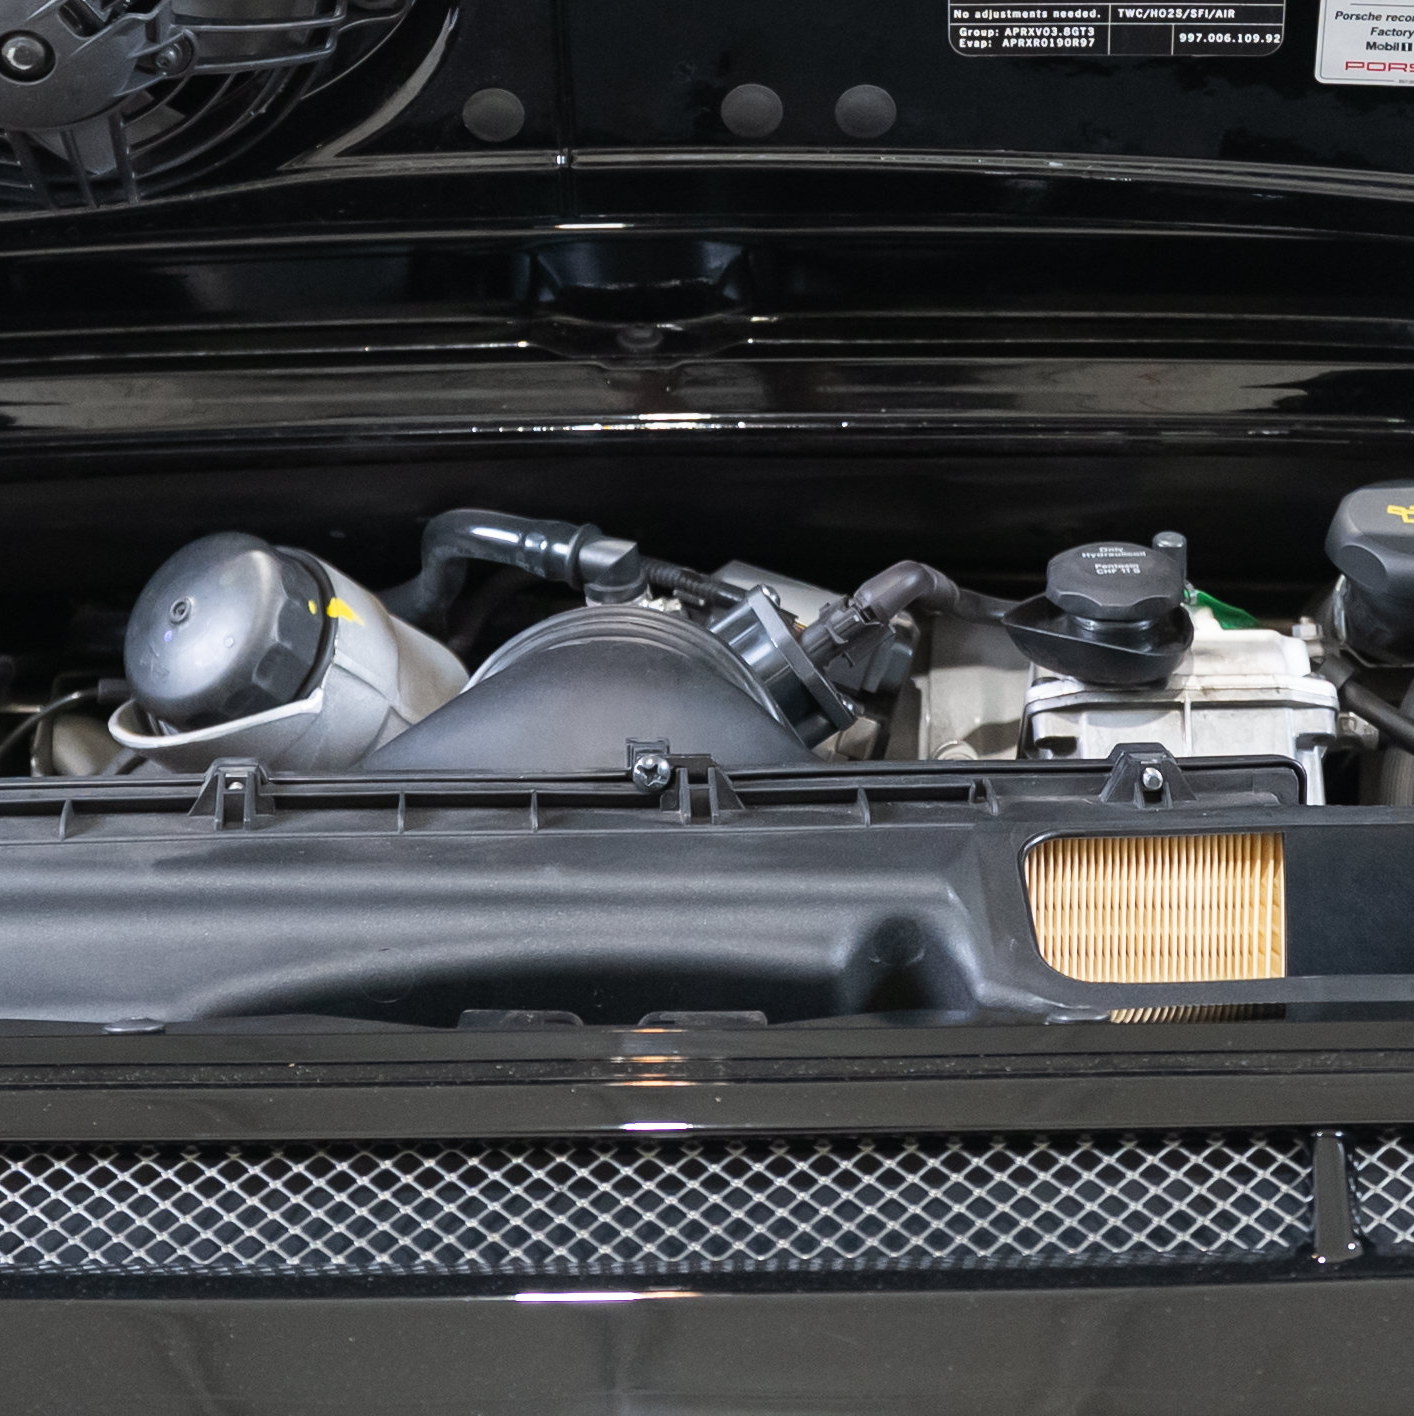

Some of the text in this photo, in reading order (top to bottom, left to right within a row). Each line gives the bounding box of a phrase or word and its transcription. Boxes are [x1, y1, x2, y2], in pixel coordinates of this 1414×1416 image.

[954, 9, 1101, 20] No adjustments needed.
[1334, 11, 1383, 22] Porsche
[959, 27, 1000, 38] Group:
[1370, 27, 1414, 39] Factory
[959, 38, 992, 49] Evap:
[1179, 33, 1281, 44] 997.006.109.92
